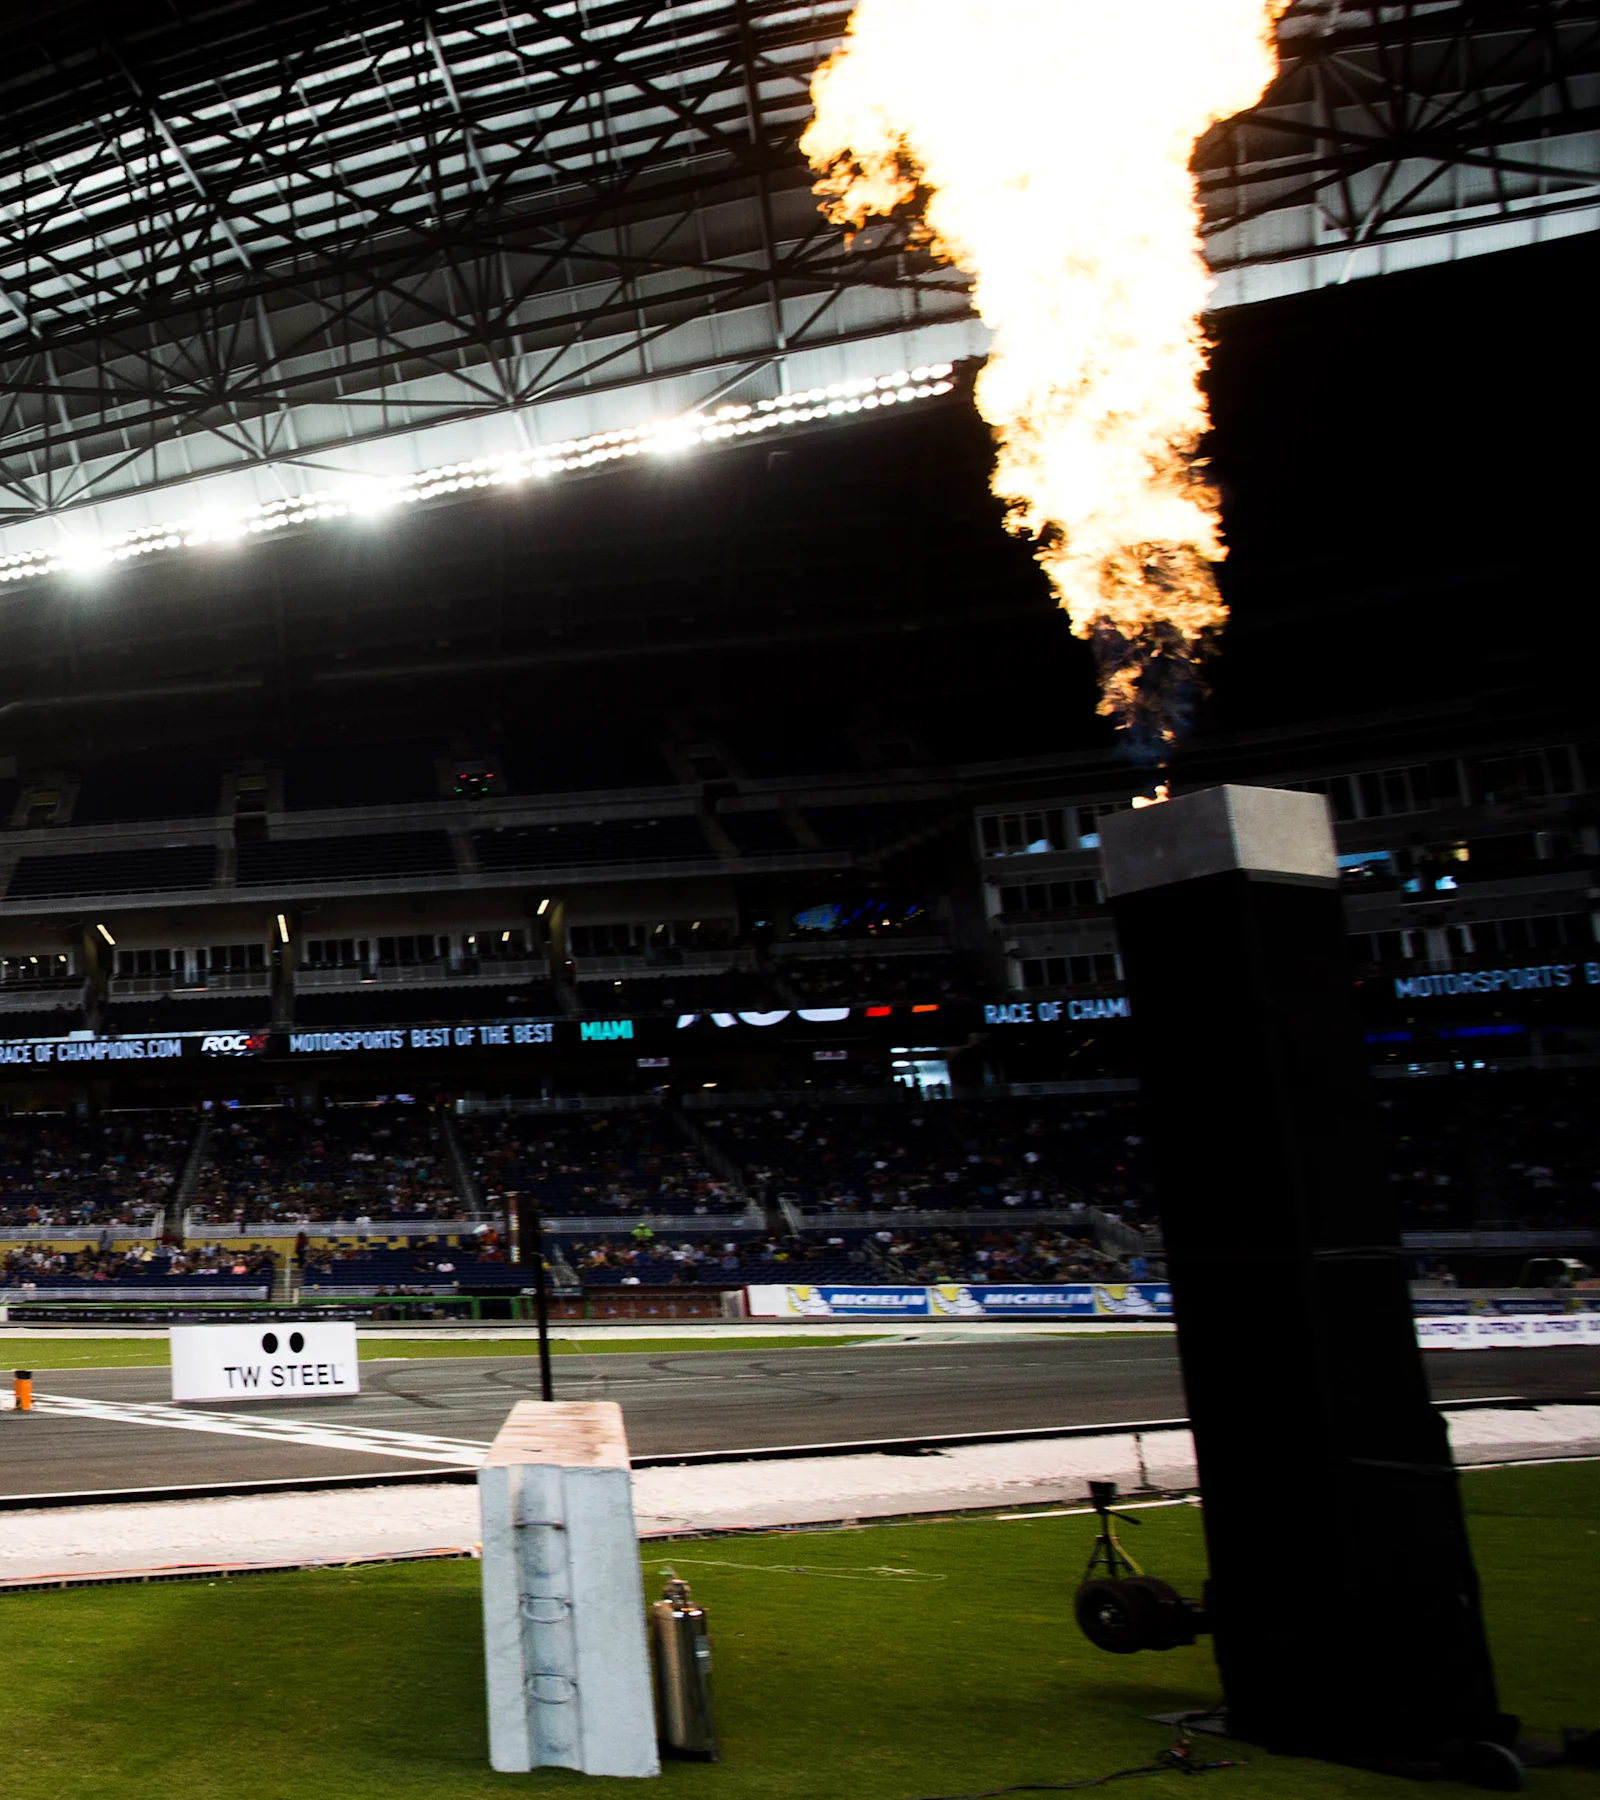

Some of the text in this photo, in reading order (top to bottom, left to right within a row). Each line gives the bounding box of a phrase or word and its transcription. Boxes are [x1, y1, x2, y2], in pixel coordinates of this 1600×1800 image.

[983, 1003, 1035, 1025] RACE
[1037, 1001, 1065, 1022] OF
[410, 1028, 453, 1048] BEST
[455, 1027, 477, 1046] OF
[479, 1026, 511, 1045] THE
[513, 1023, 555, 1044] BEST
[580, 1020, 634, 1041] MIAMI
[34, 1044, 55, 1062] OF
[57, 1039, 182, 1062] CHAMPIONS.COM
[830, 1293, 926, 1306] MICHELIN
[983, 1293, 1094, 1305] MICHELIN
[224, 1364, 344, 1388] TW STEEL
